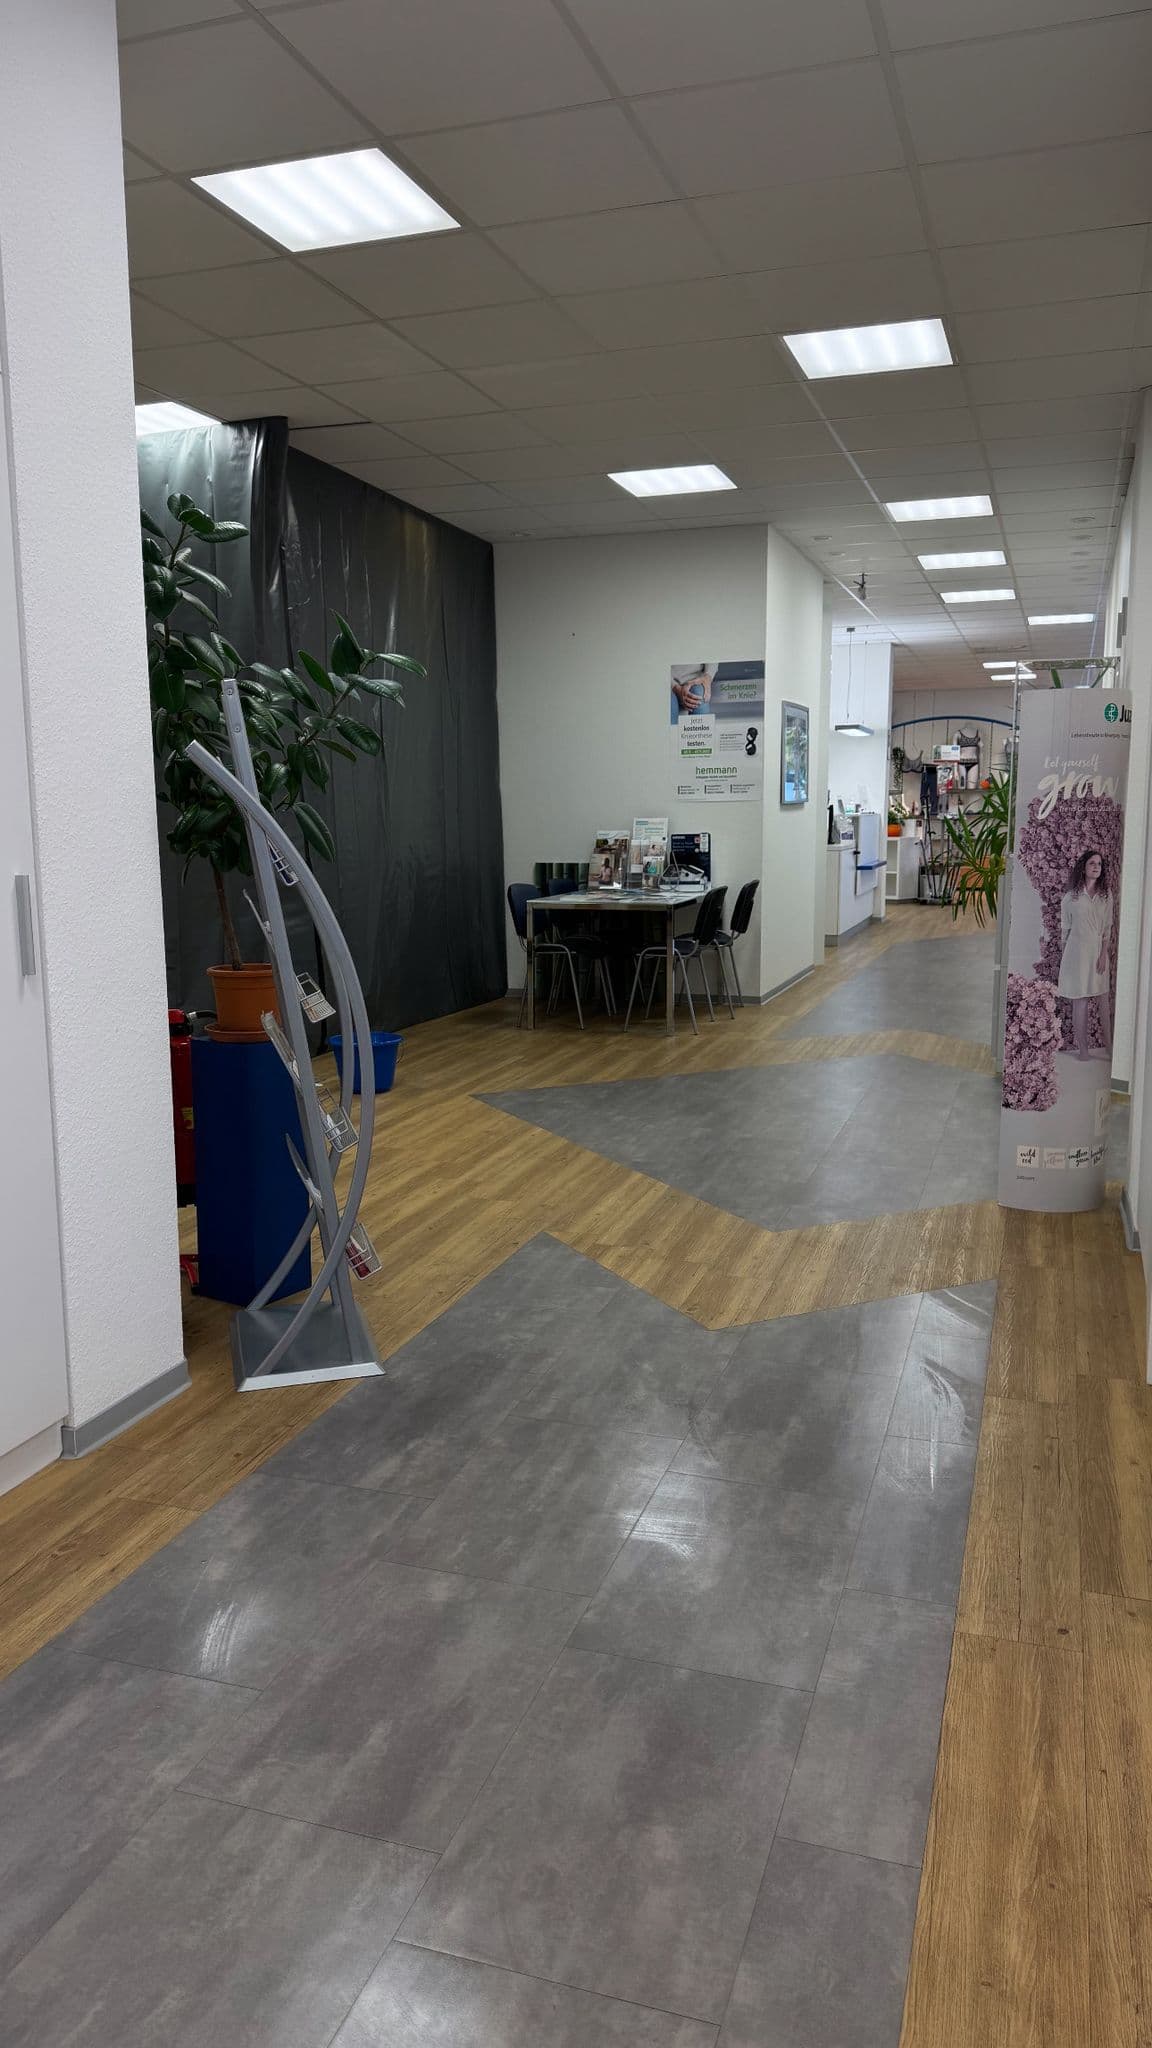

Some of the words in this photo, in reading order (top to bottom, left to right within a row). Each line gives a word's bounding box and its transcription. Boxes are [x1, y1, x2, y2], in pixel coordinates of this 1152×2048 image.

[720, 683, 757, 692] Schmerzen
[739, 691, 757, 699] Knie?
[683, 724, 710, 732] kostenlos
[681, 732, 712, 740] Knieorthese
[1044, 756, 1060, 769] Let
[1061, 753, 1099, 775] yourself
[695, 765, 738, 775] hemmann
[1037, 771, 1120, 820] grow
[1020, 1148, 1036, 1158] wild
[1021, 1157, 1032, 1165] red
